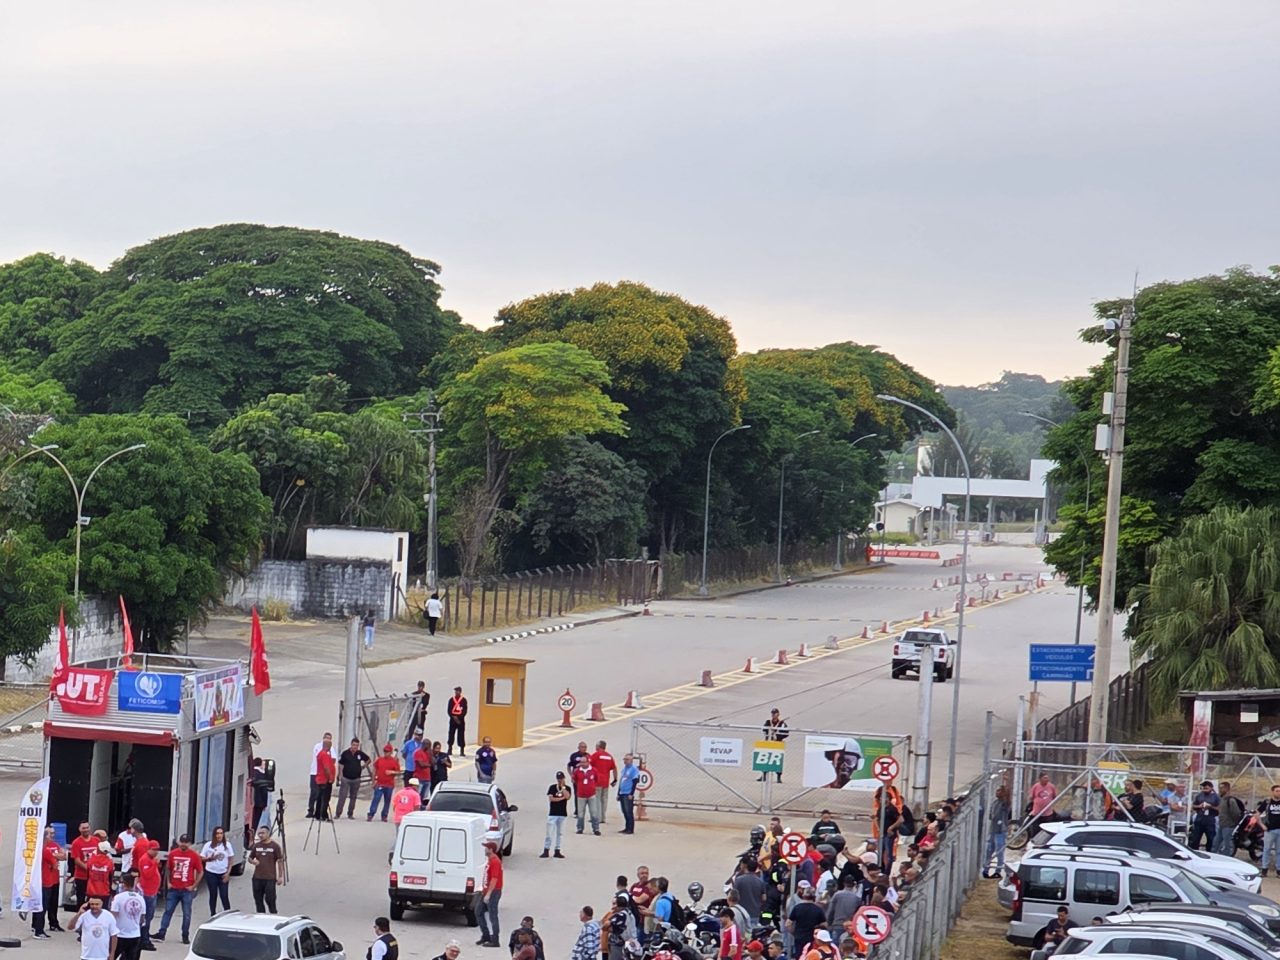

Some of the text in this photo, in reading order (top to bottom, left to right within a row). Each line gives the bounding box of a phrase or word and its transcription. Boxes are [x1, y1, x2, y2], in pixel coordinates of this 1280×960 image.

[562, 698, 572, 706] 20
[756, 751, 782, 765] BR
[1100, 774, 1128, 788] BR
